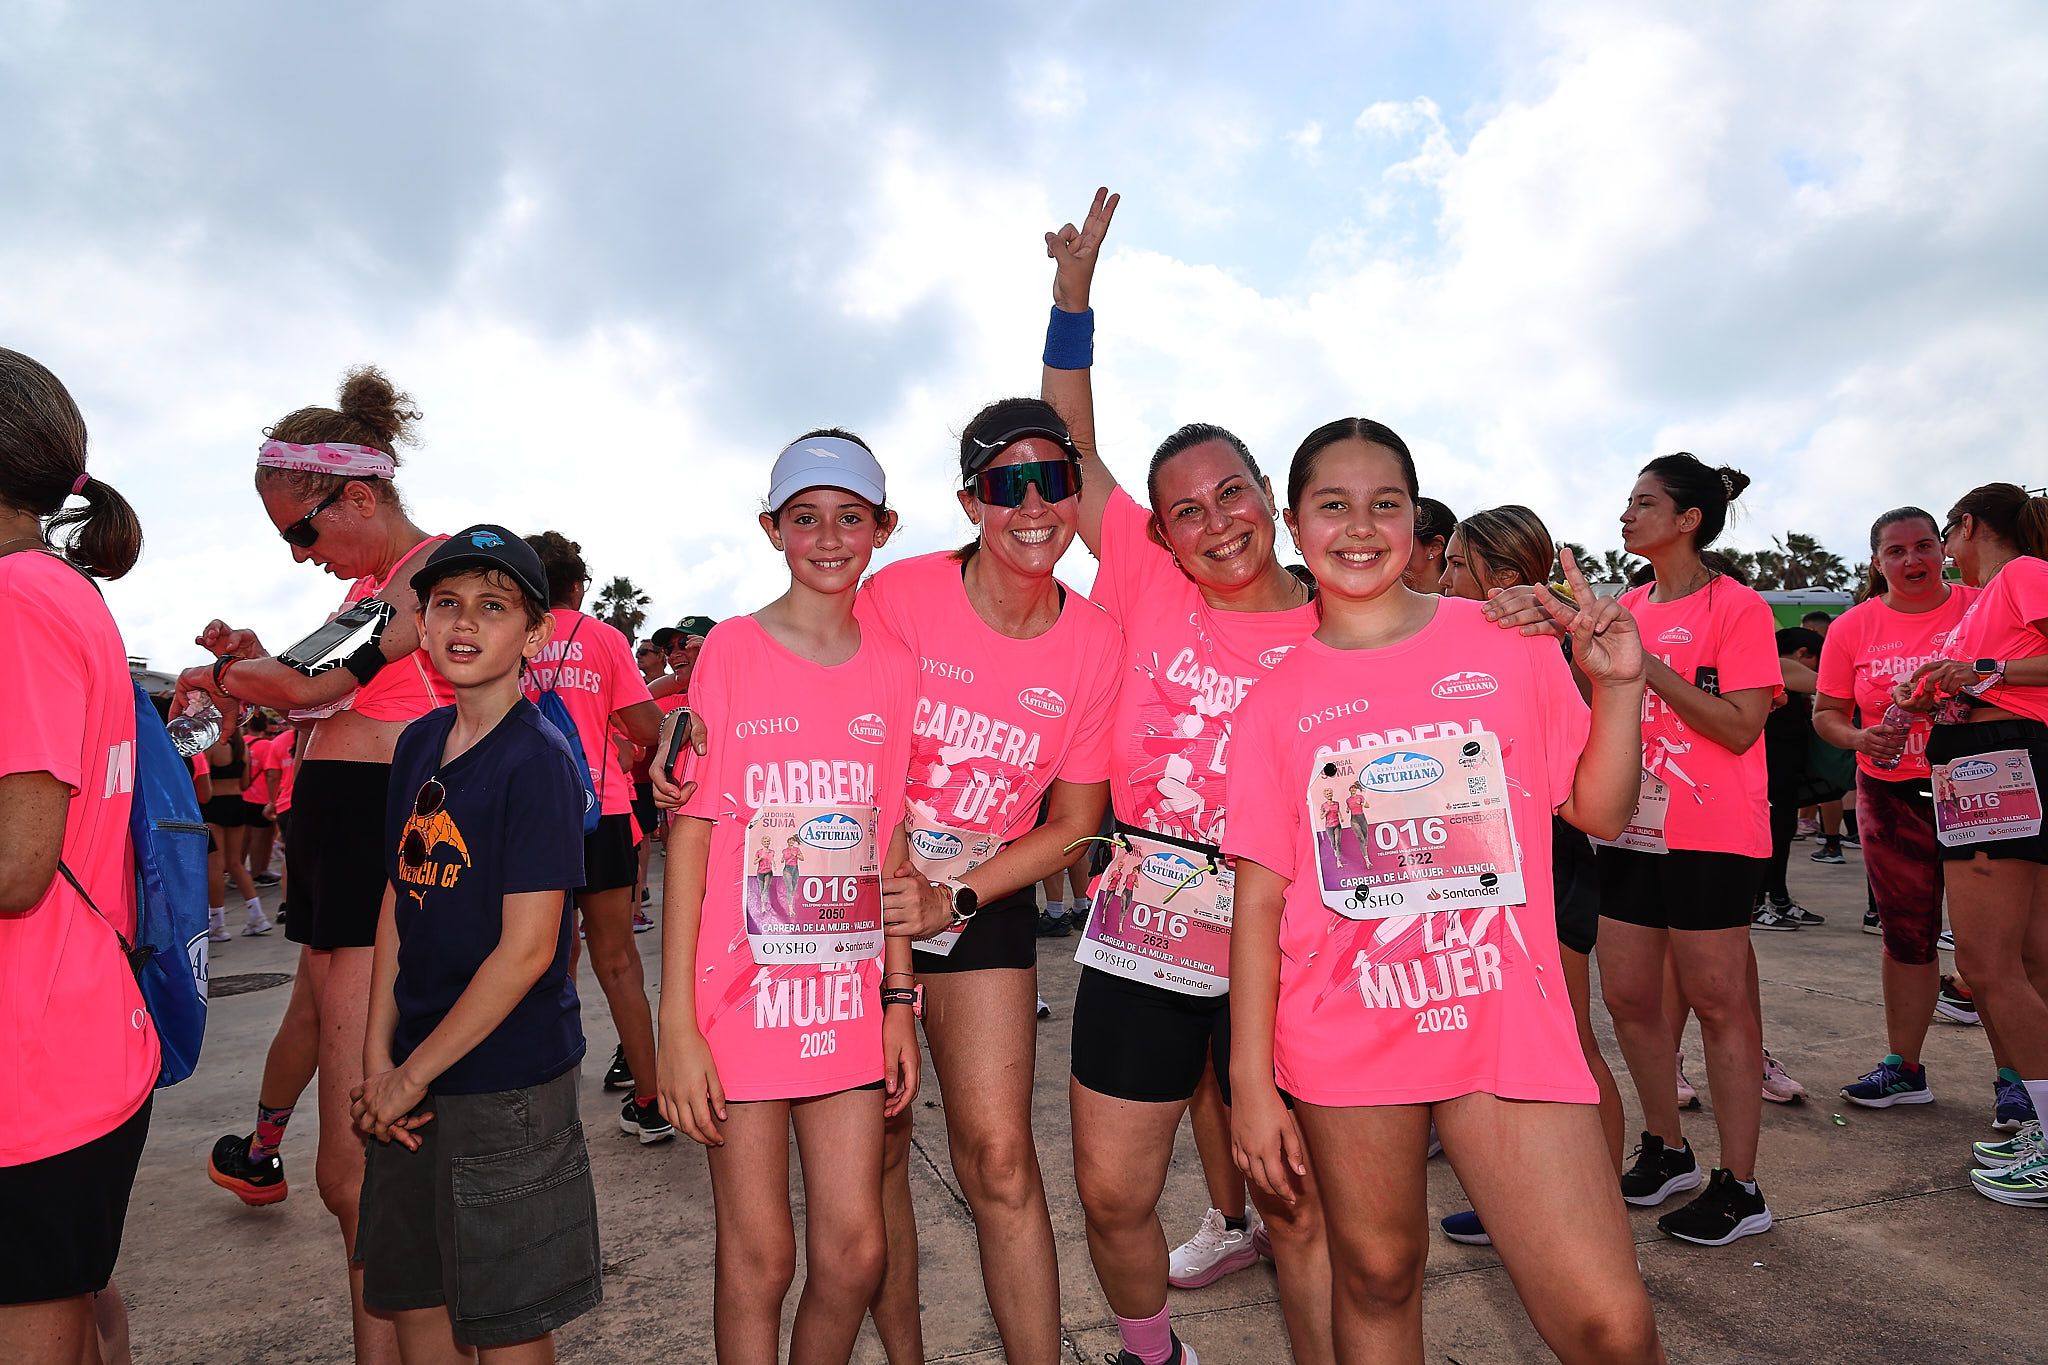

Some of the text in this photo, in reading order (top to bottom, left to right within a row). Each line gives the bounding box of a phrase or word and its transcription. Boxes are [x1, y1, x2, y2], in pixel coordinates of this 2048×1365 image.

[530, 640, 583, 664] MOS
[1867, 640, 1904, 653] OYSHO
[520, 666, 601, 694] PARABLES
[1166, 646, 1259, 713] CARRE
[1438, 681, 1495, 696] ASTURIANA
[1298, 698, 1369, 733] OYSHO
[1641, 687, 1658, 723] E
[736, 716, 799, 739] OYSHO
[912, 696, 1041, 771] CARRERA
[744, 759, 874, 809] CARRERA
[1365, 767, 1439, 786] ASTURIANA
[1954, 768, 1994, 779] ASTURIANA
[951, 768, 1011, 824] DE
[1959, 792, 2001, 811] 016
[762, 818, 796, 828] SUMA
[1945, 823, 1965, 831] CARRERA
[1979, 817, 1998, 825] MUJER
[2002, 814, 2030, 823] VALENCIA
[1996, 825, 2032, 835] Santander
[804, 826, 860, 841] ASTURIANA
[1374, 817, 1448, 851] 016
[1948, 830, 1976, 842] OYSHO
[913, 834, 958, 855] ASTURIANA
[1397, 852, 1434, 868] 2622
[441, 863, 462, 888] CF
[1340, 862, 1497, 888] CARRERA DE LA MUJER VALENCIA
[802, 876, 858, 903] 016
[1442, 885, 1500, 900] Santander
[1344, 892, 1404, 910] OYSHO
[819, 908, 845, 920] 2050
[1132, 904, 1189, 938] 016
[762, 920, 875, 933] CARRERA DE LA MUJER VALENCIA
[1192, 920, 1232, 936] CORREDOR
[1421, 910, 1469, 954] LA
[762, 942, 817, 955] OYSHO
[845, 940, 875, 952] Santander
[1098, 932, 1216, 973] CARRERA DE LA MUJER VALENCIA
[1142, 934, 1169, 950] 2623
[1094, 949, 1137, 971] OYSHO
[1165, 972, 1213, 991] Santander
[1358, 943, 1503, 1009] MUJER
[754, 972, 864, 1029] MUJER
[1414, 1005, 1468, 1034] 2026
[800, 1030, 836, 1059] 2026
